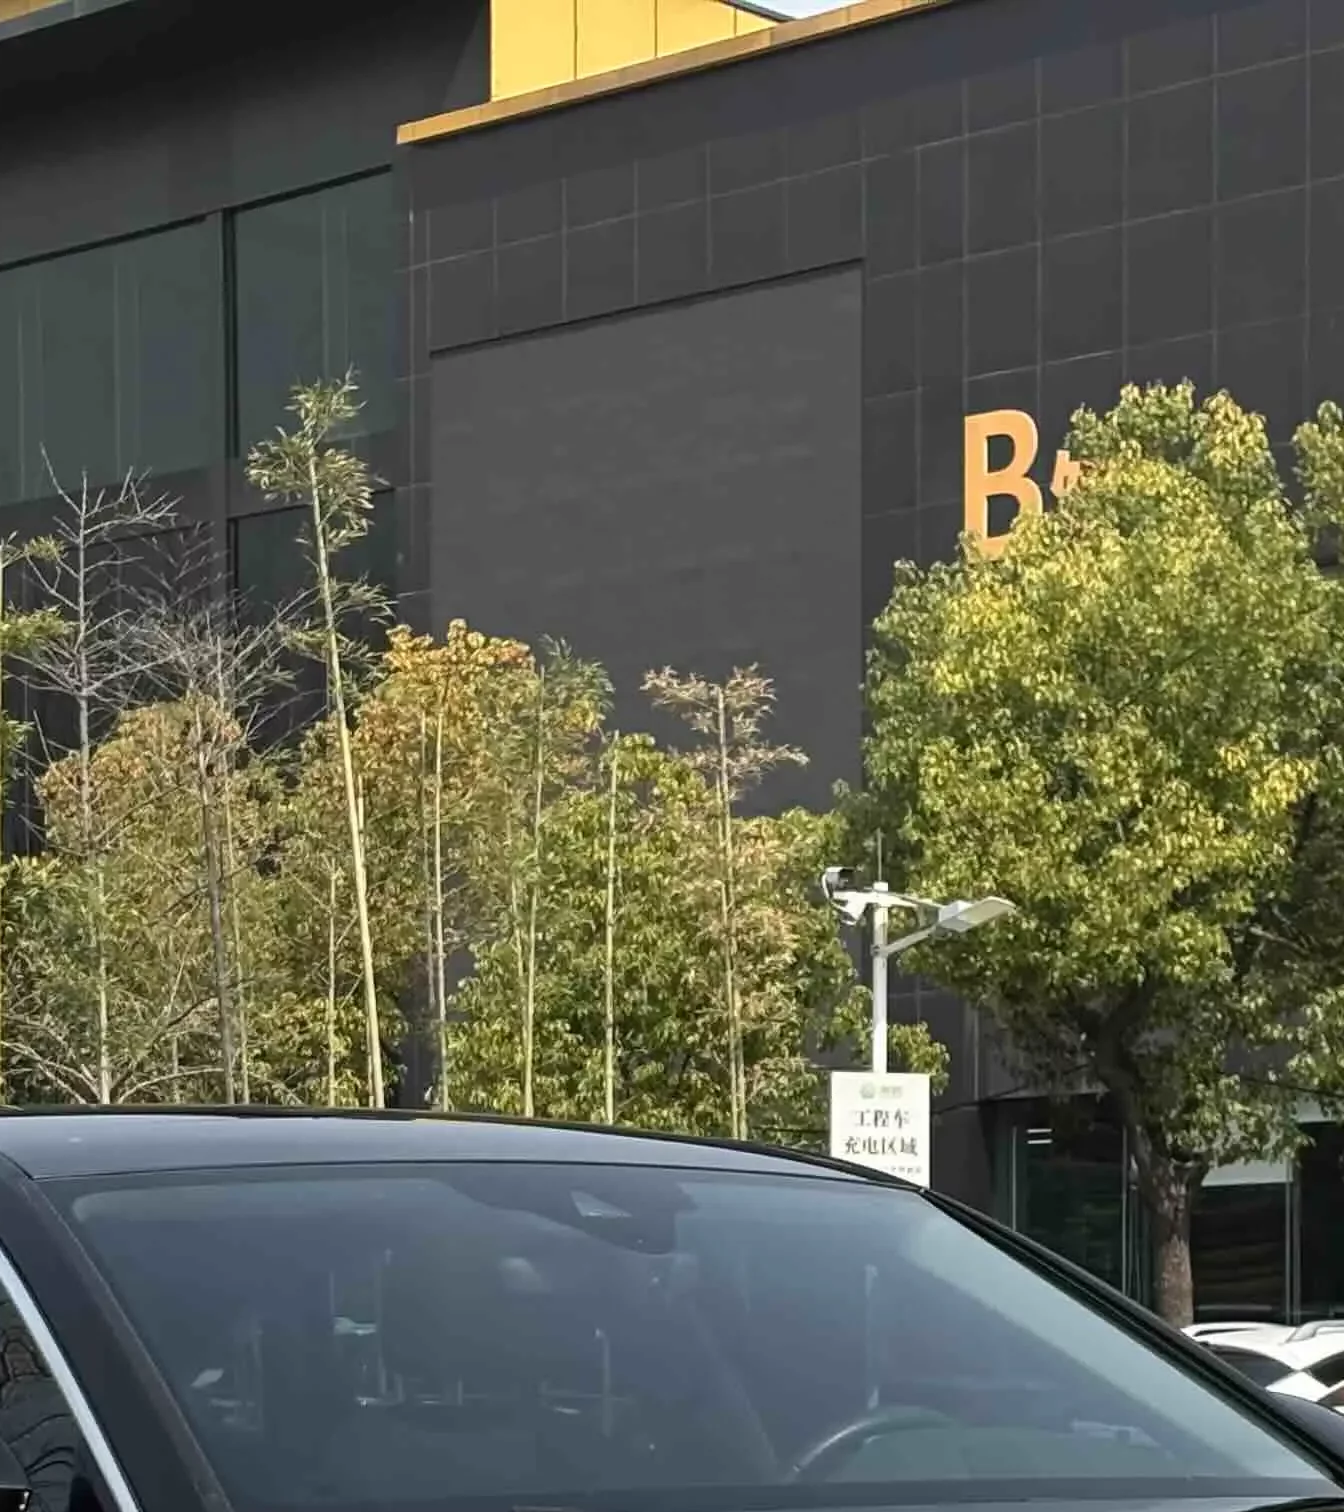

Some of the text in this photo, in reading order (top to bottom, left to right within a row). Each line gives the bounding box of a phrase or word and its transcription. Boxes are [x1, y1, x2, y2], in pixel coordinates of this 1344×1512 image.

[852, 1108, 910, 1129] 工程车
[844, 1136, 919, 1156] 充电区域
